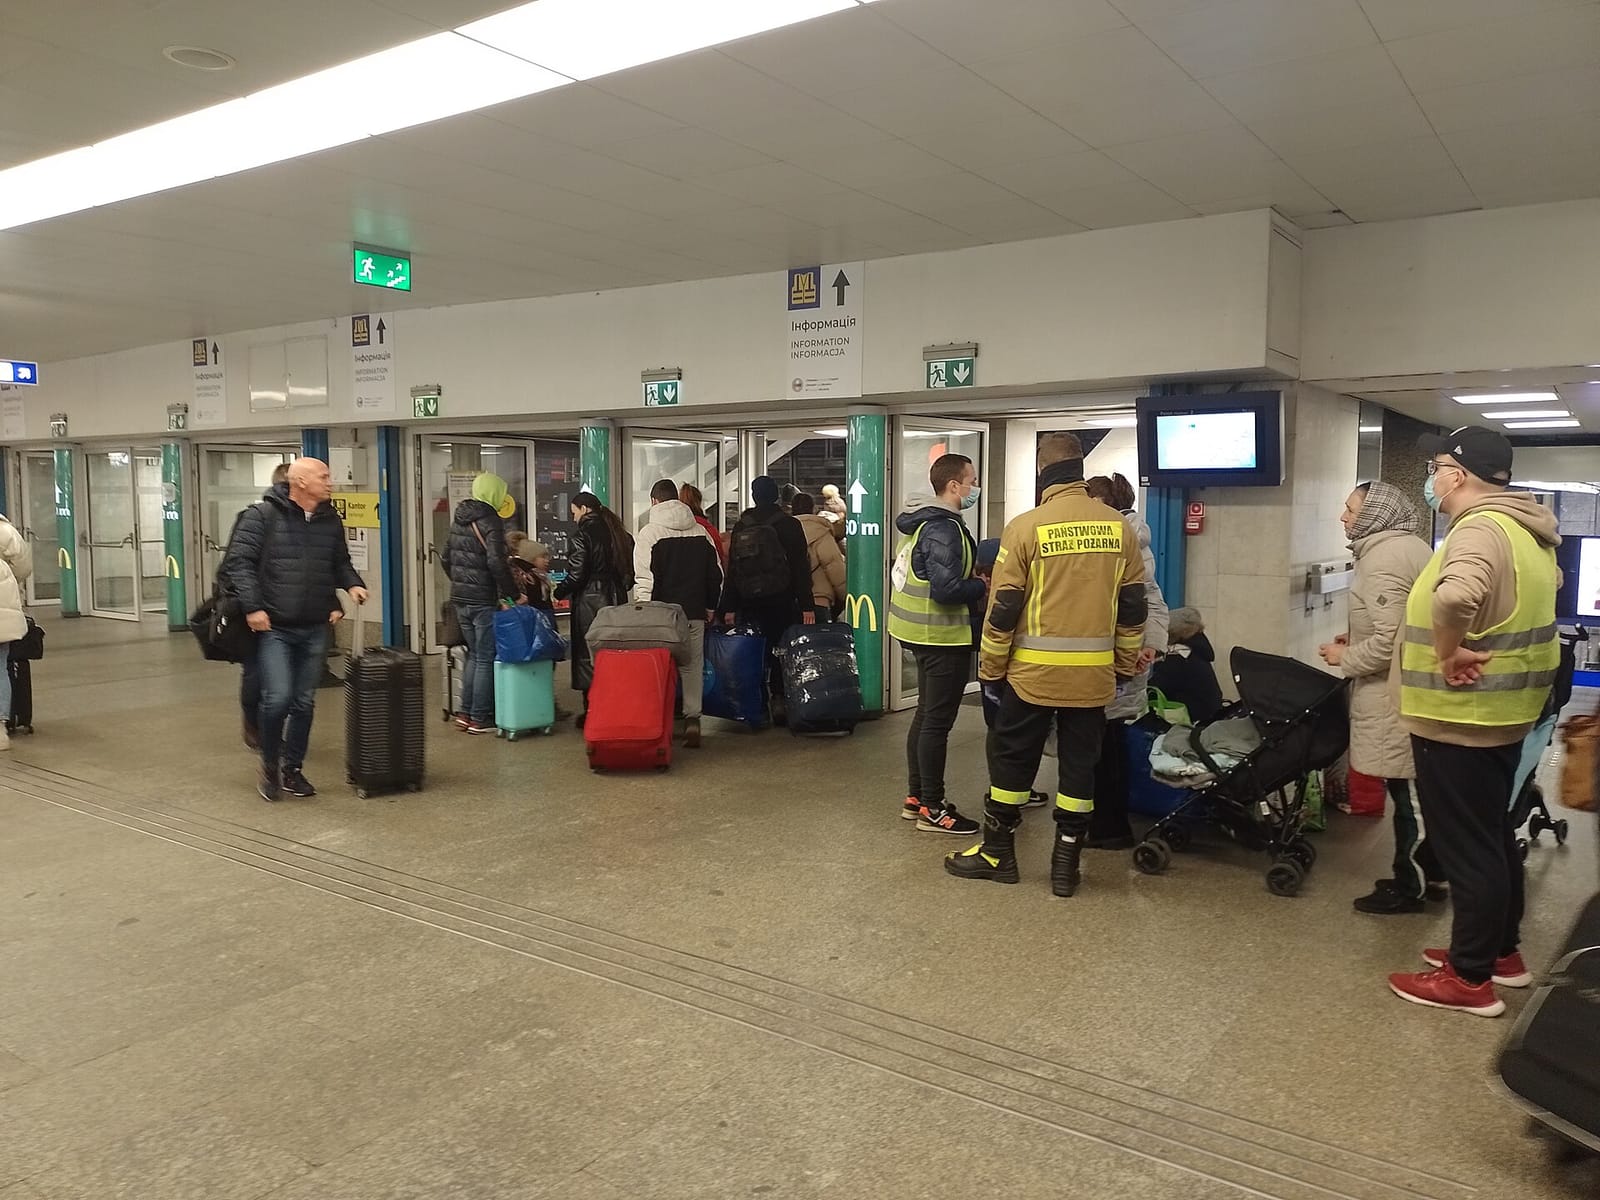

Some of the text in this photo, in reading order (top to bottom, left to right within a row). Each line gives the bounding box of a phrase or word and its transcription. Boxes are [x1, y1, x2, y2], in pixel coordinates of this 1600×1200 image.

[791, 315, 856, 332] Інформація
[791, 337, 849, 349] INFORMATION
[791, 348, 845, 359] INFORMACJA
[861, 522, 880, 536] m
[1047, 524, 1113, 540] PAŃSTWOWA
[1077, 538, 1121, 550] POŻARNA
